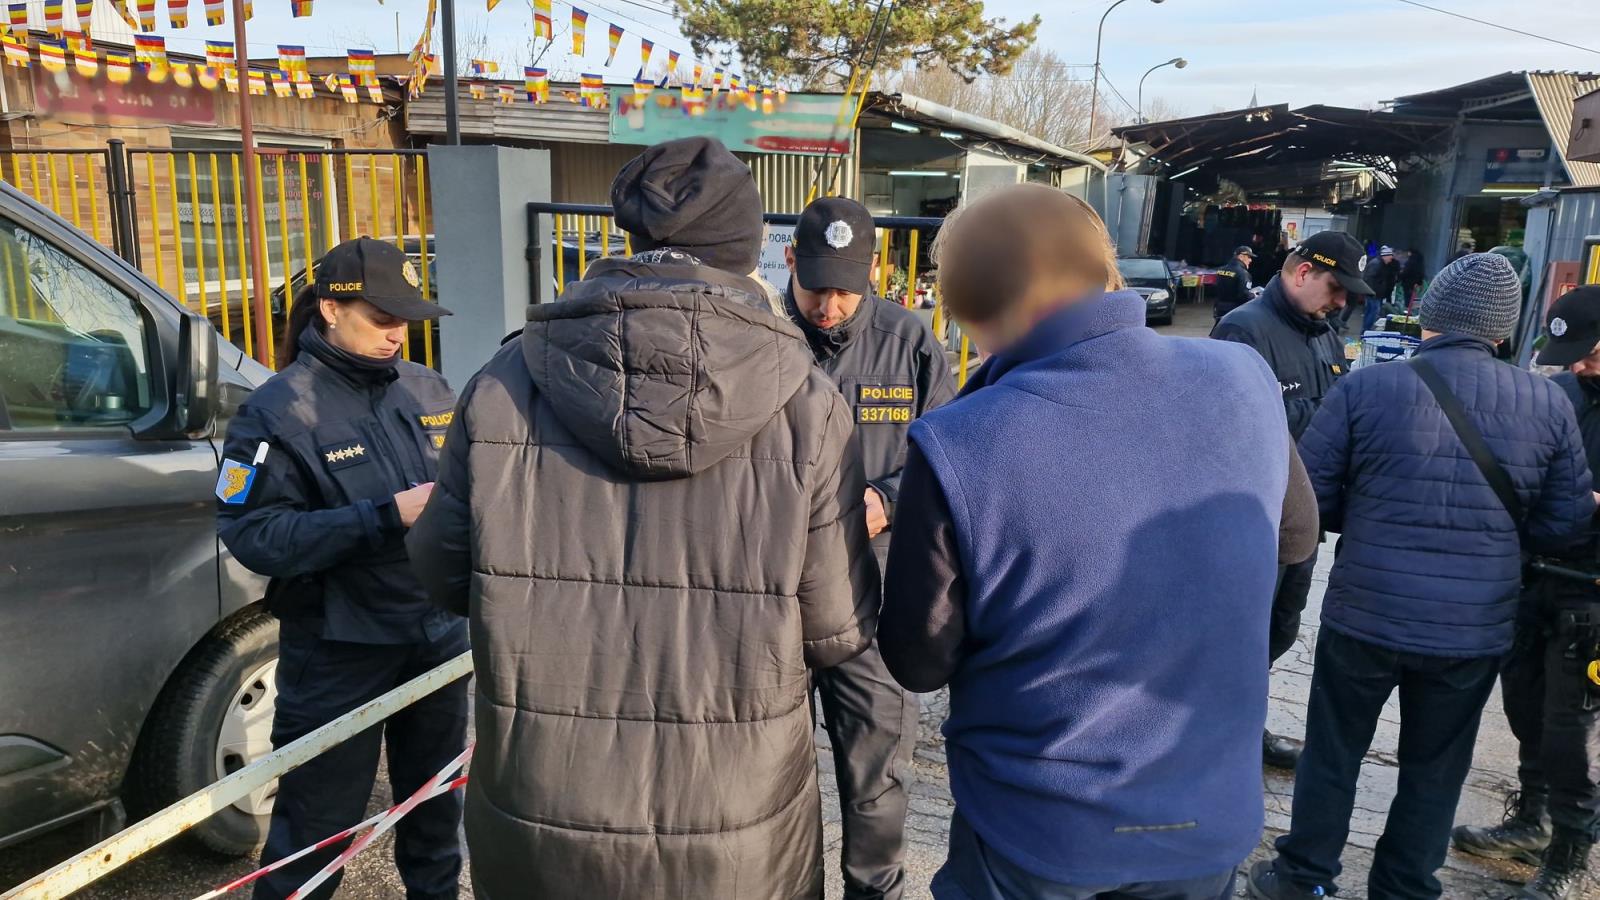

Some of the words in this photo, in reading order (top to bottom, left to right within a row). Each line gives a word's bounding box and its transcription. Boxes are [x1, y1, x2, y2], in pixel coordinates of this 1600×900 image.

[1312, 253, 1337, 267] POLICIE
[329, 282, 362, 291] POLICIE
[862, 387, 913, 399] POLICIE
[861, 407, 909, 421] 337168
